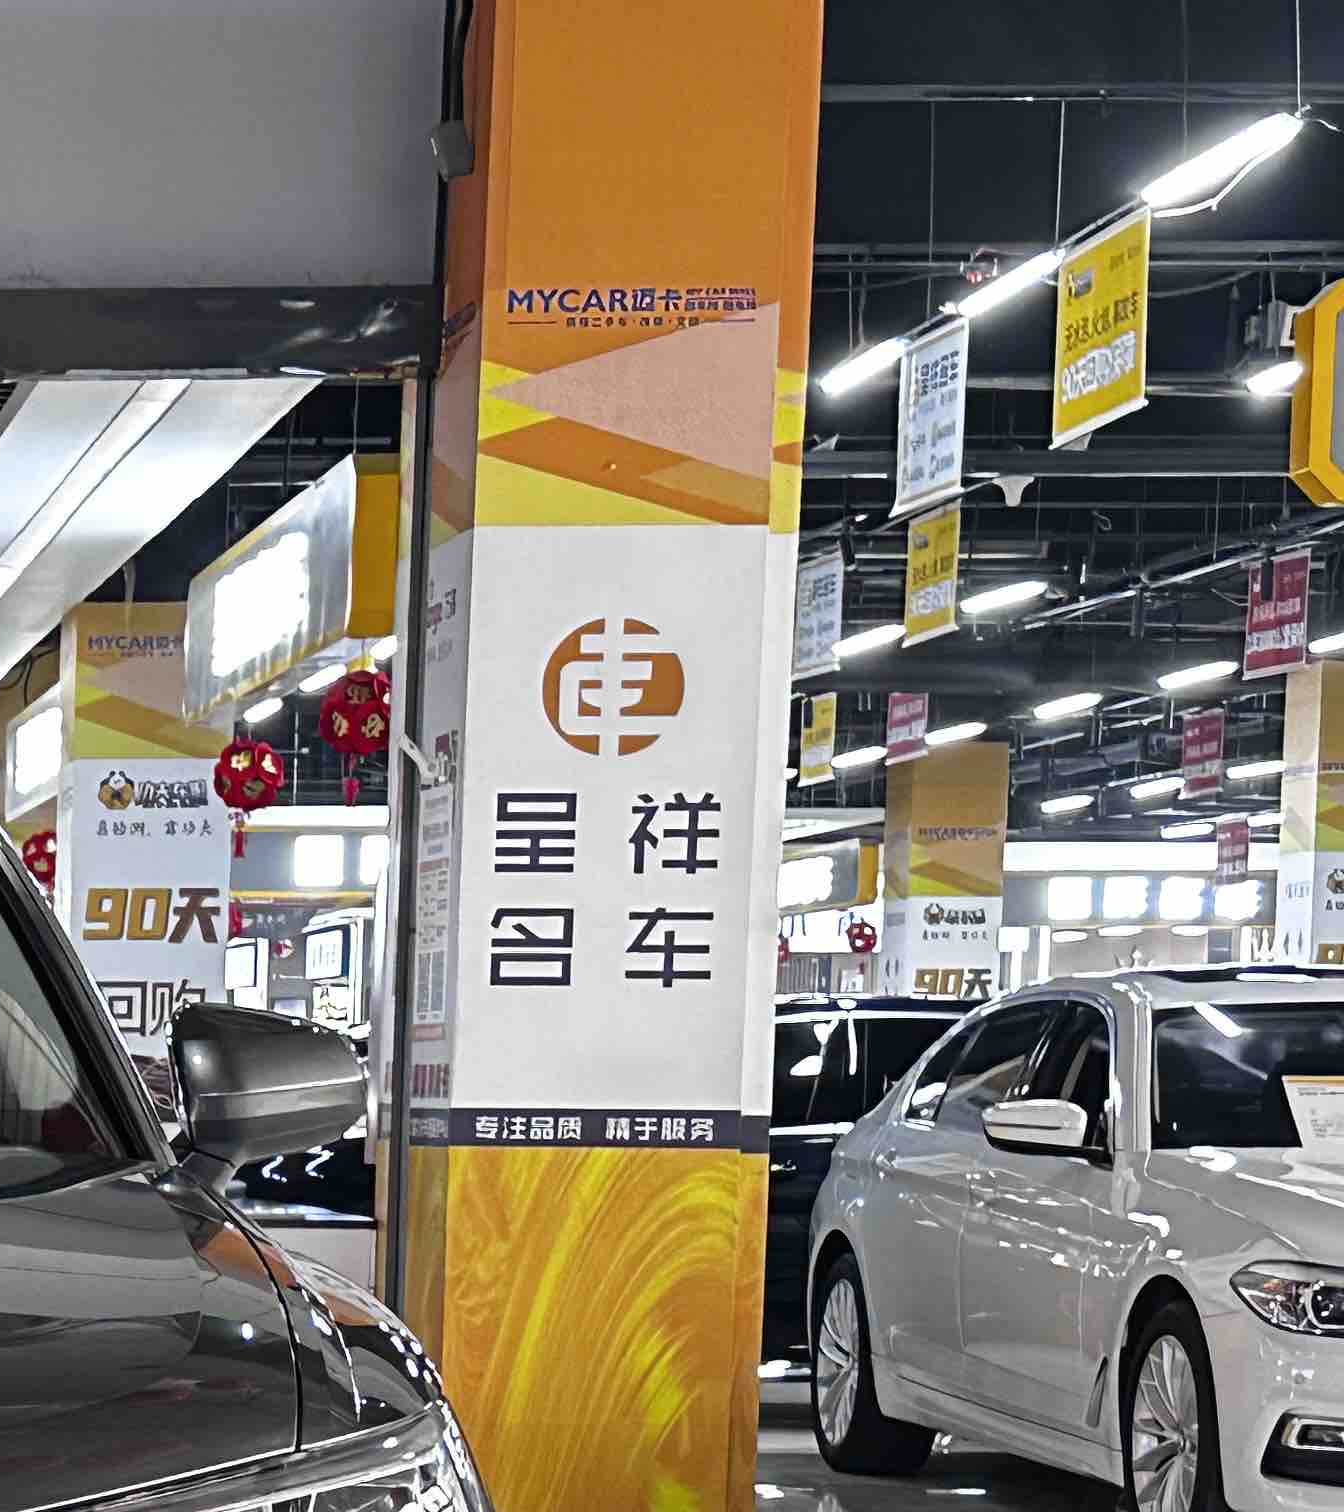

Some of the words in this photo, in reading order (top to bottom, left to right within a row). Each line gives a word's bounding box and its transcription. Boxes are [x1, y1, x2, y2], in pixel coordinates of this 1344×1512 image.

[493, 792, 722, 875] 呈祥
[83, 887, 221, 944] 90天
[489, 906, 715, 989] 名车
[914, 967, 994, 1000] 90天
[474, 1115, 583, 1142] 专注品质
[605, 1115, 715, 1143] 精于服务
